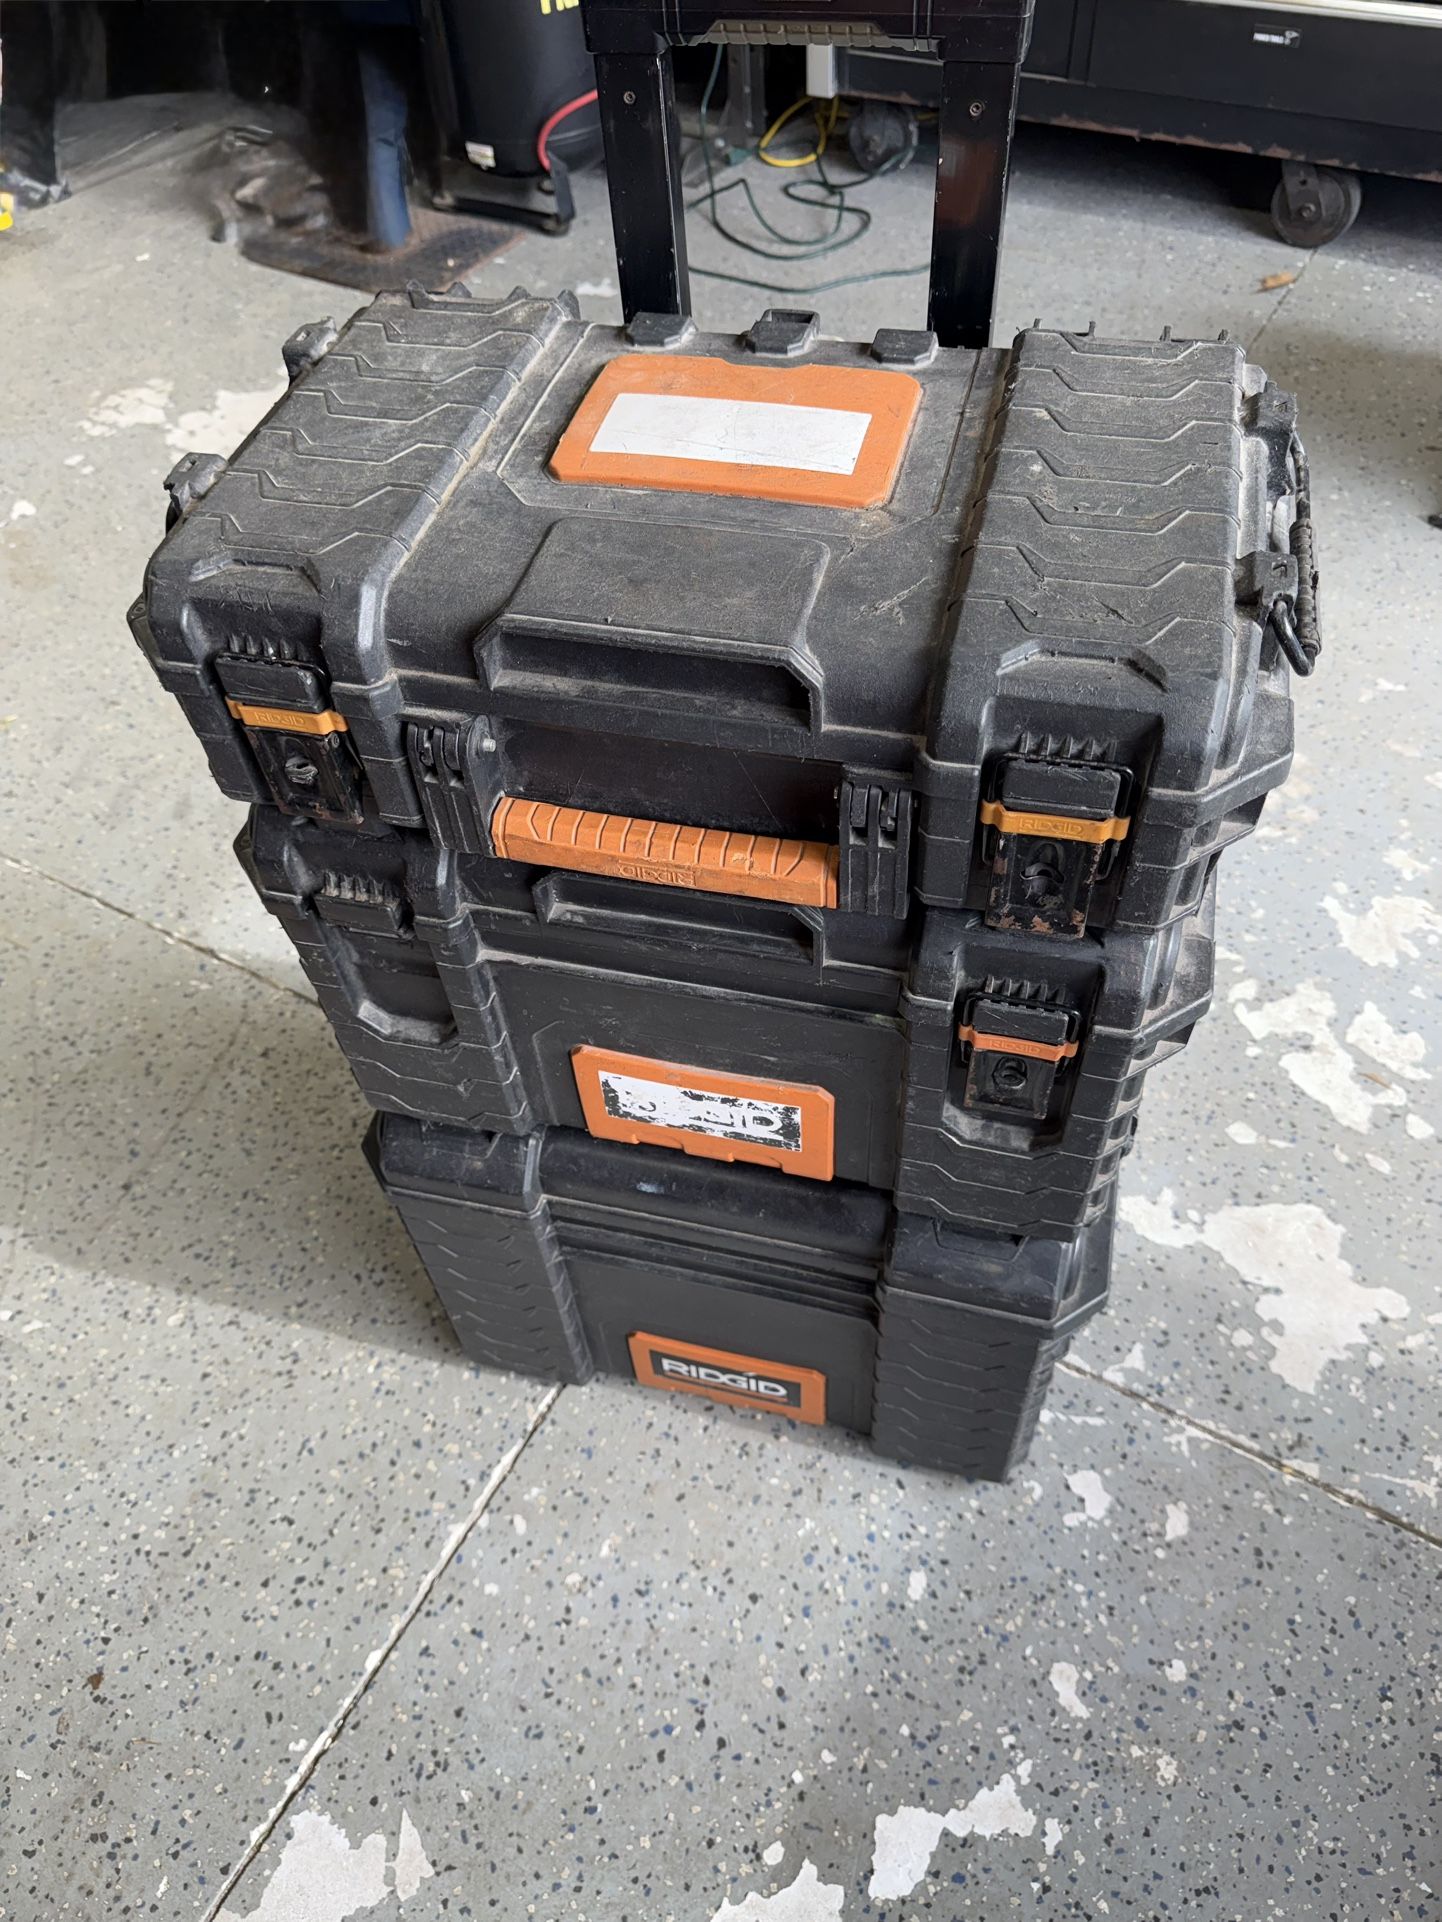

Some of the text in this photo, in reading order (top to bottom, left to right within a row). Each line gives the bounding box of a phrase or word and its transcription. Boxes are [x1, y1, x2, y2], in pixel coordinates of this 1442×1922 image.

[1019, 818, 1082, 835] RIDGID
[618, 864, 696, 886] RIDGID
[661, 1357, 788, 1397] RIDGID
